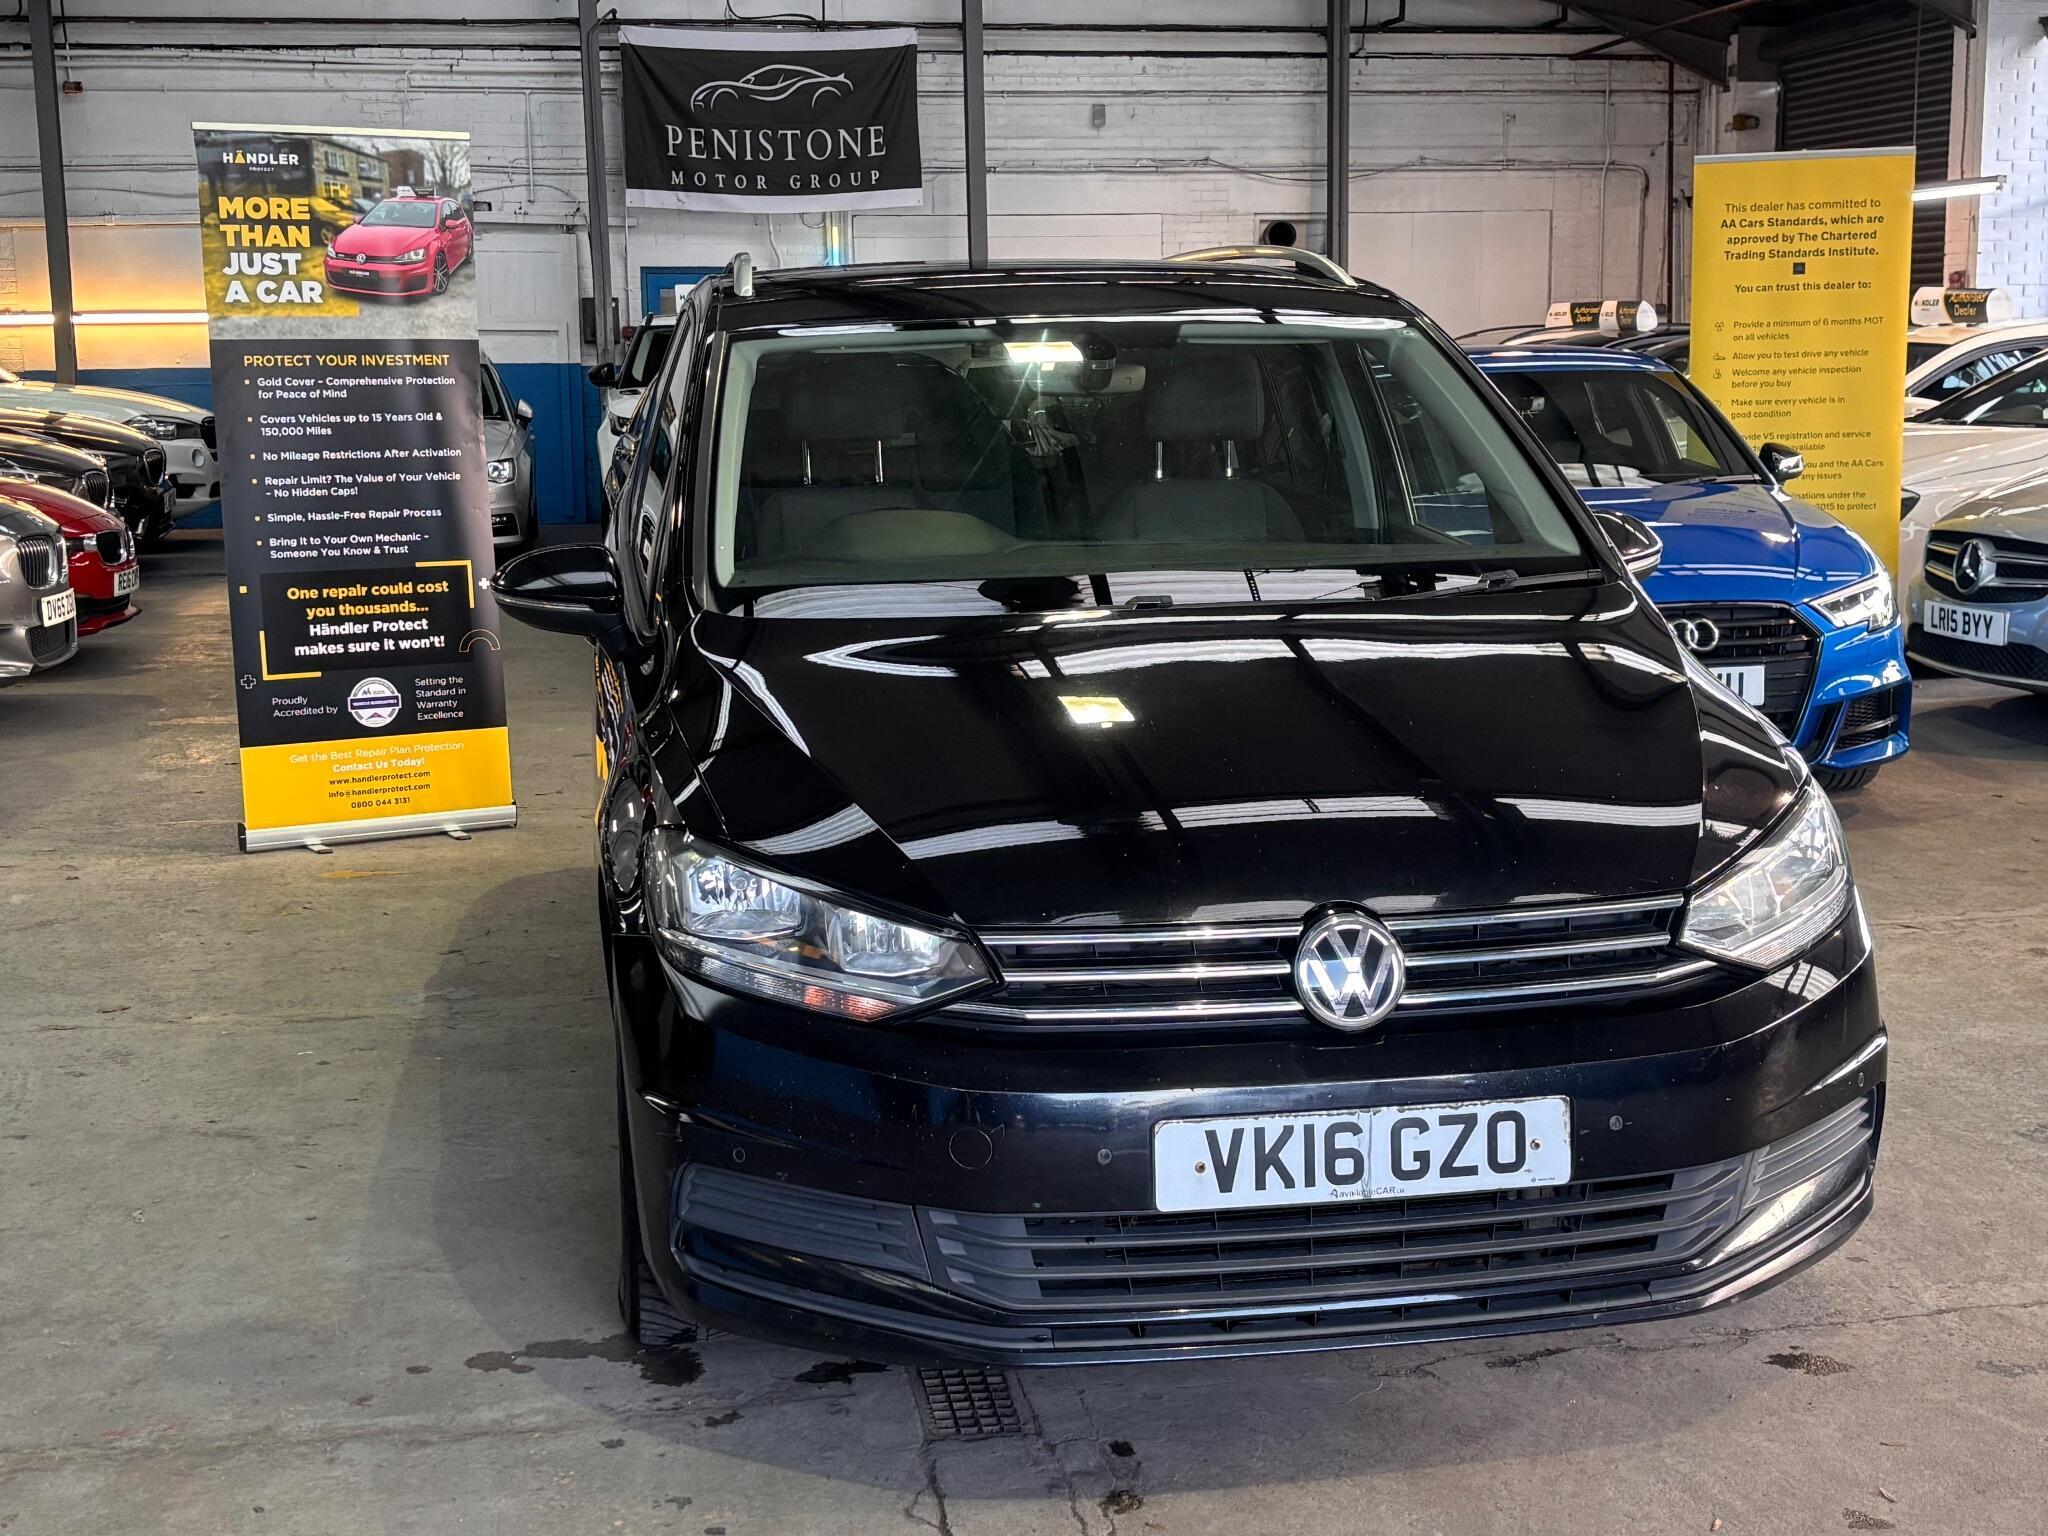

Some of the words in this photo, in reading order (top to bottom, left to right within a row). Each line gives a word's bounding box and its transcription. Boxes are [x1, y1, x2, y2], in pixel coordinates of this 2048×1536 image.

[665, 124, 886, 162] PENISTONE
[671, 170, 767, 189] MOTOR
[789, 170, 880, 188] GROUP
[218, 196, 310, 220] MORE
[1725, 203, 1747, 213] This
[1750, 202, 1784, 212] dealer
[1786, 201, 1806, 211] has
[1808, 199, 1867, 209] committed
[1720, 219, 1737, 229] AA
[1739, 219, 1764, 228] Cars
[1767, 216, 1828, 228] Standards,
[1830, 215, 1864, 225] which
[1866, 215, 1884, 224] are
[219, 224, 310, 248] THAN
[1726, 234, 1779, 245] approved
[1781, 233, 1795, 243] by
[1797, 233, 1818, 242] The
[1820, 231, 1877, 240] Chartered
[1724, 250, 1765, 261] Trading
[1768, 248, 1826, 259] Standards
[1828, 247, 1879, 257] Institute.
[222, 252, 302, 276] JUST
[224, 280, 250, 304] A
[256, 280, 324, 304] CAR
[1735, 284, 1753, 293] You
[1755, 284, 1773, 292] can
[1776, 283, 1800, 291] trust
[1802, 282, 1821, 291] this
[1823, 281, 1855, 290] dealer
[1857, 280, 1871, 289] to:
[1954, 304, 1977, 316] Dealer
[1733, 320, 1765, 328] Provide
[1773, 319, 1811, 327] minimum
[1830, 317, 1862, 325] months
[1756, 332, 1790, 340] vehicles
[244, 355, 312, 367] PROTECT
[316, 355, 357, 366] YOUR
[361, 354, 450, 366] INVESTMENT
[1732, 352, 1755, 360] Allow
[1783, 350, 1799, 358] test
[1801, 349, 1822, 358] drive
[1823, 350, 1838, 358] any
[1839, 349, 1869, 357] vehicle
[1732, 368, 1770, 376] Welcome
[1772, 369, 1787, 377] any
[1788, 366, 1817, 375] vehicle
[1819, 365, 1861, 375] inspection
[257, 377, 282, 386] Gold
[284, 377, 315, 386] Cover
[326, 376, 403, 388] Comprehensive
[405, 376, 455, 385] Protection
[1731, 380, 1758, 388] before
[1776, 380, 1792, 388] buy
[258, 390, 273, 399] for
[276, 390, 307, 399] Peace
[323, 389, 347, 398] Mind
[1731, 398, 1753, 406] Make
[1774, 399, 1797, 407] every
[1798, 396, 1828, 404] vehicle
[260, 414, 296, 424] Covers
[298, 414, 341, 423] Vehicles
[384, 413, 413, 422] Years
[415, 412, 433, 421] Old
[1730, 411, 1752, 420] good
[1753, 410, 1792, 418] condition
[261, 427, 304, 437] 150,000
[306, 426, 332, 435] Miles
[1776, 432, 1823, 440] registration
[263, 452, 278, 461] No
[280, 451, 320, 461] Mileage
[323, 450, 381, 460] Restrictions
[384, 449, 409, 458] After
[412, 448, 461, 458] Activation
[265, 476, 298, 487] Repair
[301, 475, 332, 485] Limit?
[334, 474, 353, 483] The
[355, 473, 384, 483] Value
[399, 472, 423, 482] Your
[425, 471, 461, 481] Vehicle
[274, 489, 289, 498] No
[292, 488, 328, 497] Hidden
[330, 486, 358, 497] Caps!
[1846, 502, 1876, 511] protect
[267, 513, 306, 523] Simple,
[308, 510, 366, 521] Hassle-Free
[369, 509, 401, 519] Repair
[403, 508, 442, 518] Process
[269, 537, 298, 547] Bring
[323, 535, 348, 544] Your
[350, 534, 373, 543] Own
[375, 532, 421, 542] Mechanic
[270, 549, 318, 558] Someone
[320, 548, 341, 557] You
[343, 546, 371, 556] Know
[383, 544, 409, 554] Trust
[287, 587, 318, 600] One
[322, 584, 368, 599] repair
[371, 582, 413, 596] could
[416, 580, 449, 593] cost
[306, 607, 336, 620] you
[339, 601, 429, 617] thousands...
[309, 621, 369, 637] Händler
[373, 618, 429, 633] Protect
[1931, 605, 1957, 633] LR15
[1961, 611, 1993, 639] BYY
[294, 643, 344, 657] makes
[348, 642, 381, 653] sure
[415, 676, 446, 688] Setting
[448, 675, 464, 685] the
[415, 687, 456, 698] Standard
[272, 696, 308, 707] Proudly
[417, 699, 458, 711] Warranty
[273, 707, 324, 718] Accredited
[417, 710, 464, 721] Excellence
[290, 754, 309, 764] Get
[311, 753, 328, 762] the
[330, 750, 352, 761] Best
[356, 748, 387, 760] Repair
[390, 746, 411, 756] Plan
[413, 741, 464, 753] Protection
[332, 761, 373, 773] Contact
[375, 760, 389, 770] Us
[391, 757, 425, 770] Today!
[329, 770, 431, 786] www.handlerprotect.com
[351, 800, 374, 809] 0800
[375, 799, 392, 807] 044
[394, 797, 411, 805] 3131
[1204, 1120, 1365, 1194] VK16
[1389, 1109, 1527, 1181] GZO
